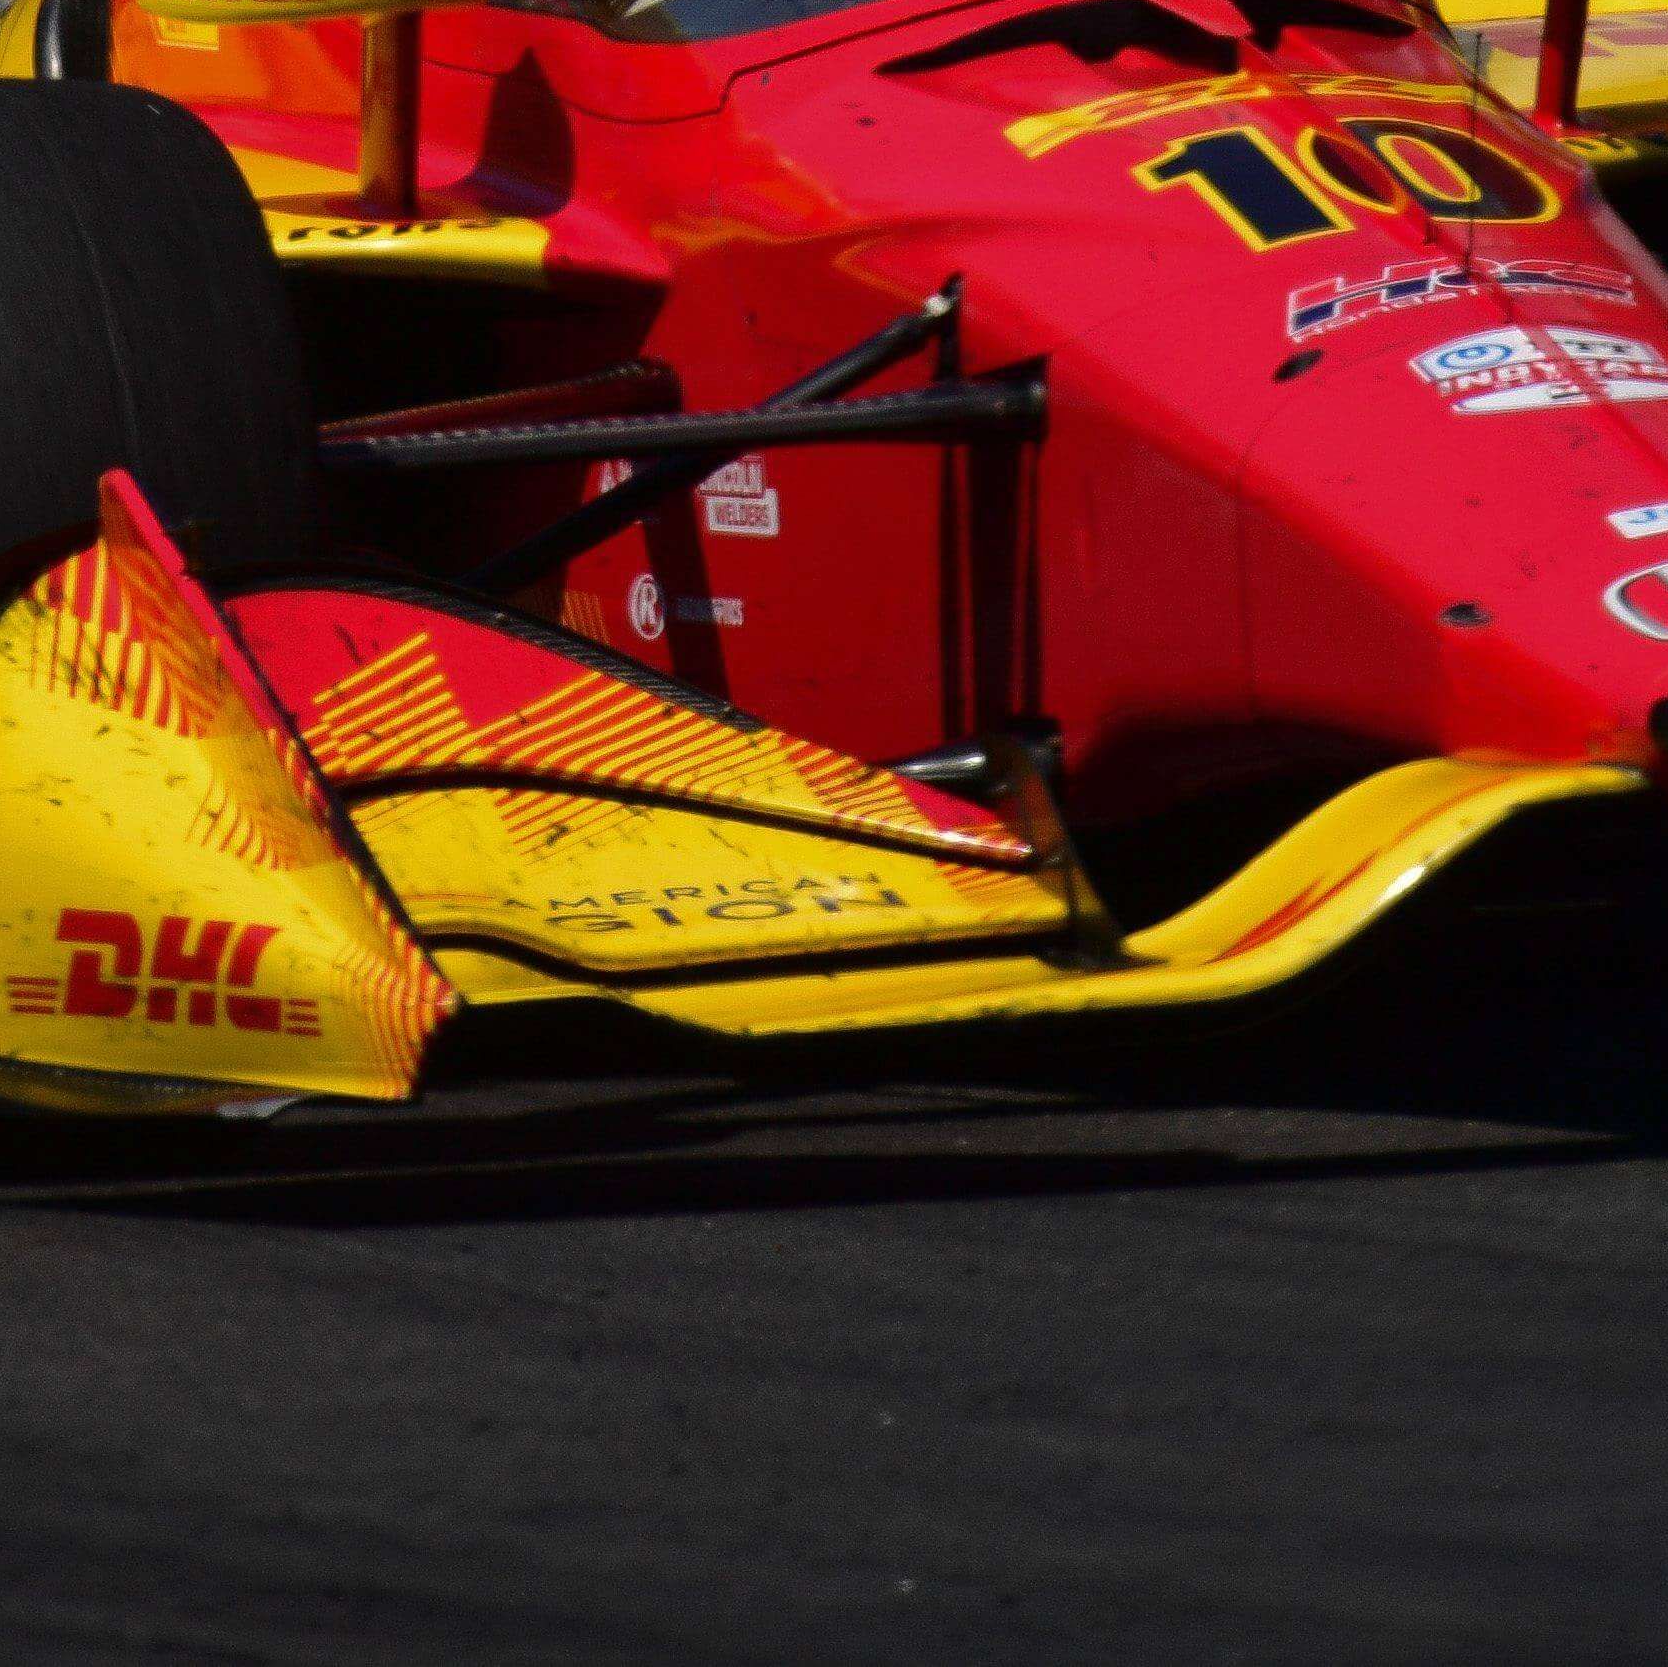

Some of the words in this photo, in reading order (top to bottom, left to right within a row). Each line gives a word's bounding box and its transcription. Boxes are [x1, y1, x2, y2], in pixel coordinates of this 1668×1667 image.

[1133, 117, 1560, 252] 10
[501, 872, 884, 912] AMERICAN
[545, 888, 910, 933] GION
[55, 907, 282, 1034] DHL
